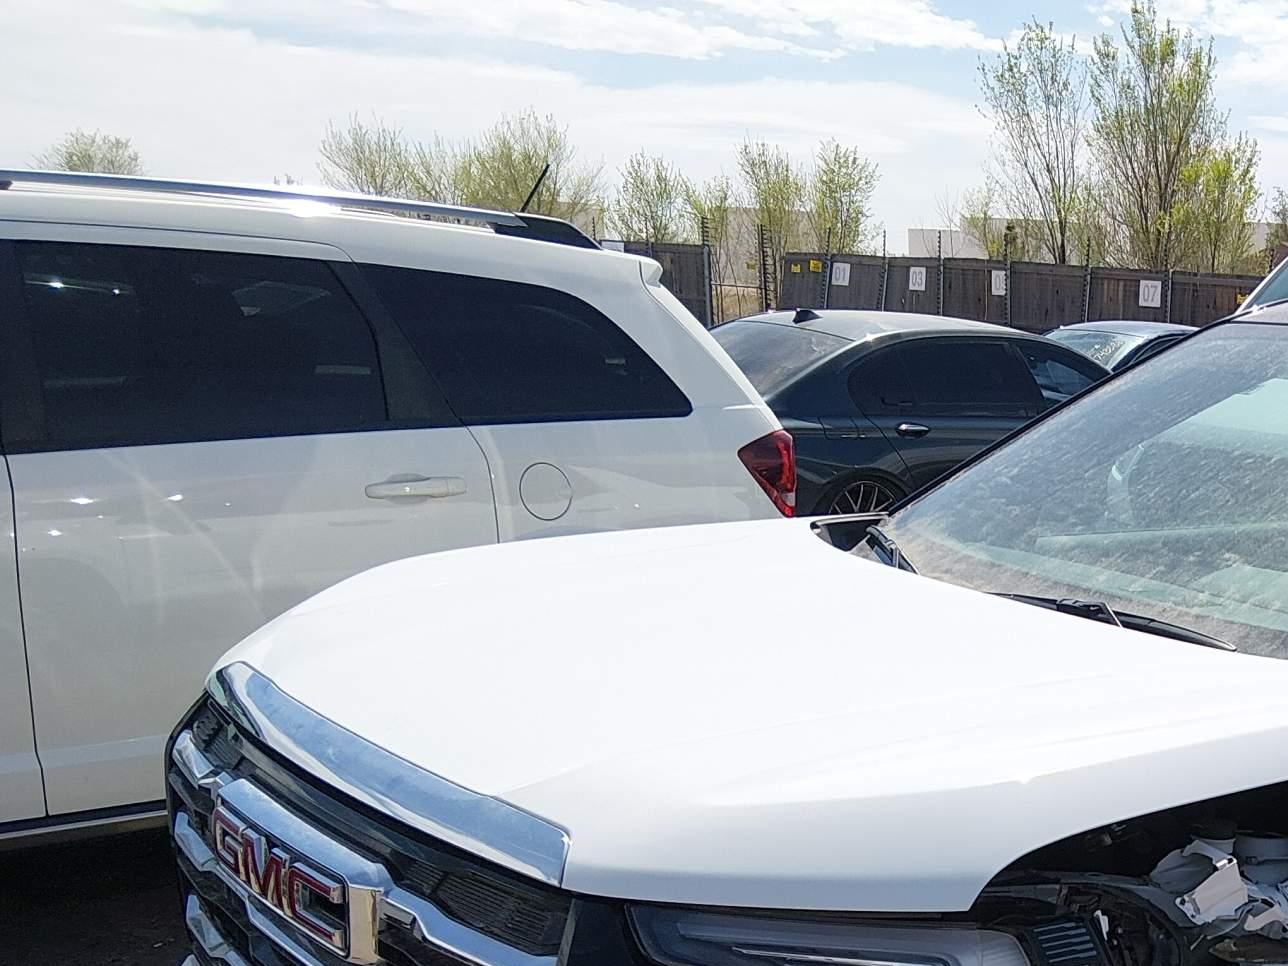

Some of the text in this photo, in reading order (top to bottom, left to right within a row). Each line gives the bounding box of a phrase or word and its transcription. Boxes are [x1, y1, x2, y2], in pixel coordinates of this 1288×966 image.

[911, 271, 923, 287] 03
[1143, 283, 1159, 303] 07
[211, 805, 346, 951] GMC
